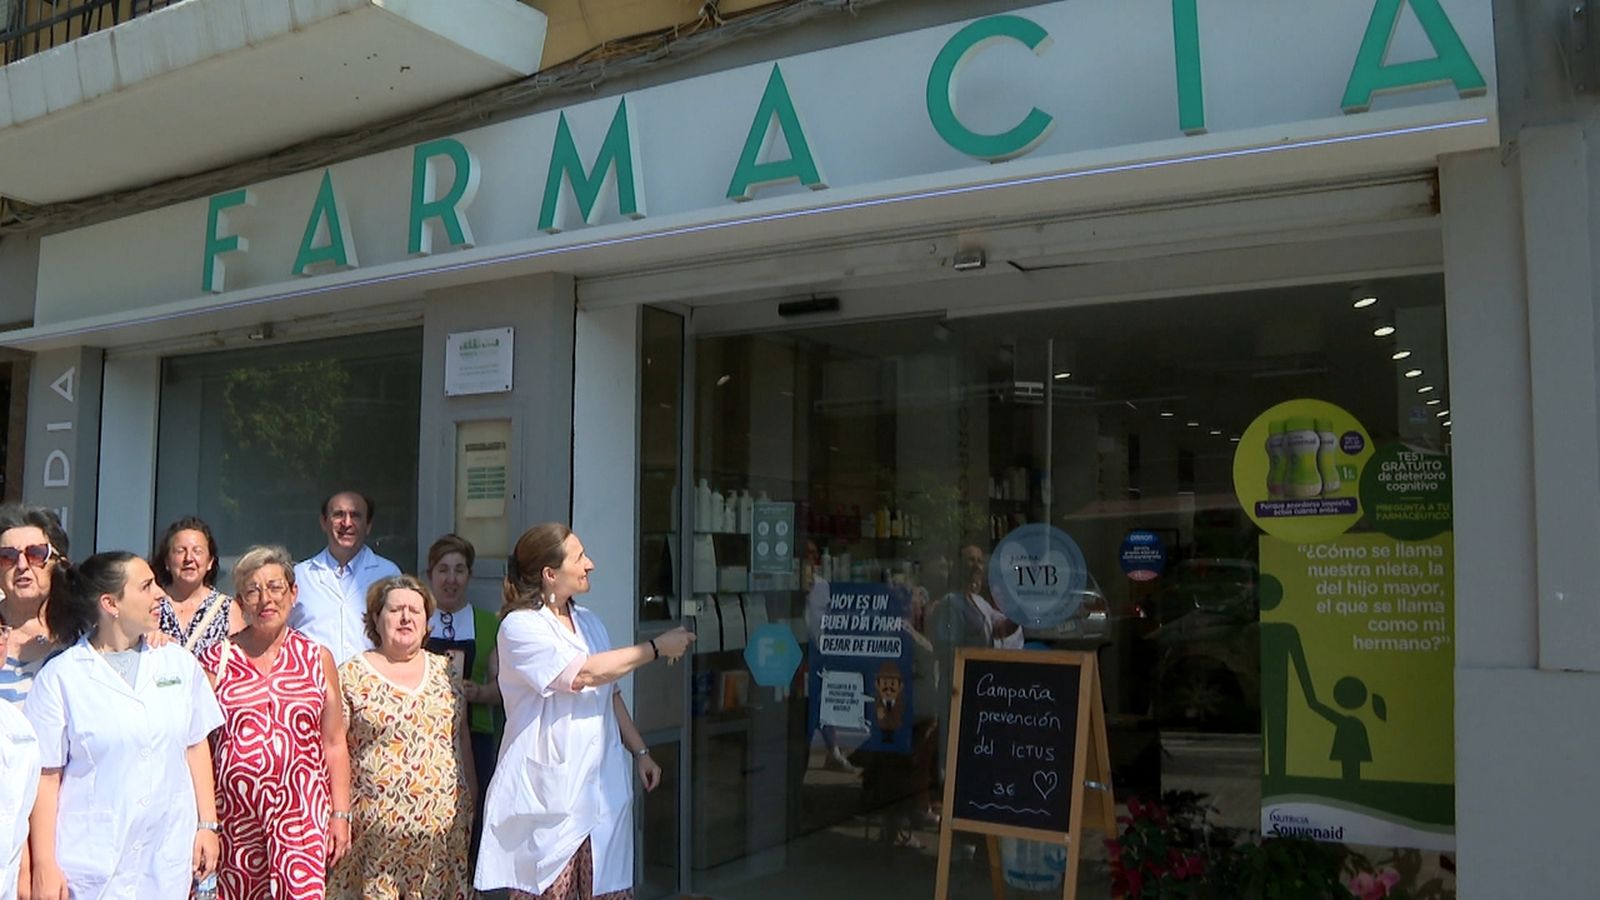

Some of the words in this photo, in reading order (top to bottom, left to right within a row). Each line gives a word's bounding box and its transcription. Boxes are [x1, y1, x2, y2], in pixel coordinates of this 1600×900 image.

[201, 0, 1487, 293] FARMACIA
[1396, 451, 1425, 461] TEST
[1381, 460, 1442, 471] GRATUITO
[1378, 471, 1392, 481] de
[1394, 470, 1446, 481] deterioro
[1386, 481, 1439, 493] cognitivo
[1436, 502, 1450, 511] TU
[1371, 545, 1390, 558] se
[1395, 542, 1443, 558] llama
[1308, 564, 1371, 577] nuestra
[1375, 562, 1424, 579] nieta,
[1428, 561, 1444, 576] la
[1316, 580, 1342, 595] del
[1347, 580, 1378, 597] hijo
[1383, 582, 1445, 597] mayor,
[830, 593, 855, 610] HOY
[856, 593, 871, 610] ES
[872, 594, 889, 610] UN
[1316, 599, 1331, 613] el
[1335, 601, 1368, 616] que
[1373, 601, 1391, 613] se
[1397, 599, 1445, 613] llama
[820, 614, 849, 630] BUEN
[872, 615, 902, 632] PARA
[1368, 619, 1418, 632] como
[1423, 617, 1445, 632] mi
[822, 638, 850, 651] DEJAR
[852, 639, 865, 652] DE
[866, 640, 900, 653] FUMAR
[976, 673, 1055, 706] Campaña
[977, 711, 1061, 735] prevención
[973, 735, 994, 756] del
[1011, 741, 1055, 761] ICTUS
[1272, 822, 1344, 840] Souvenaid
